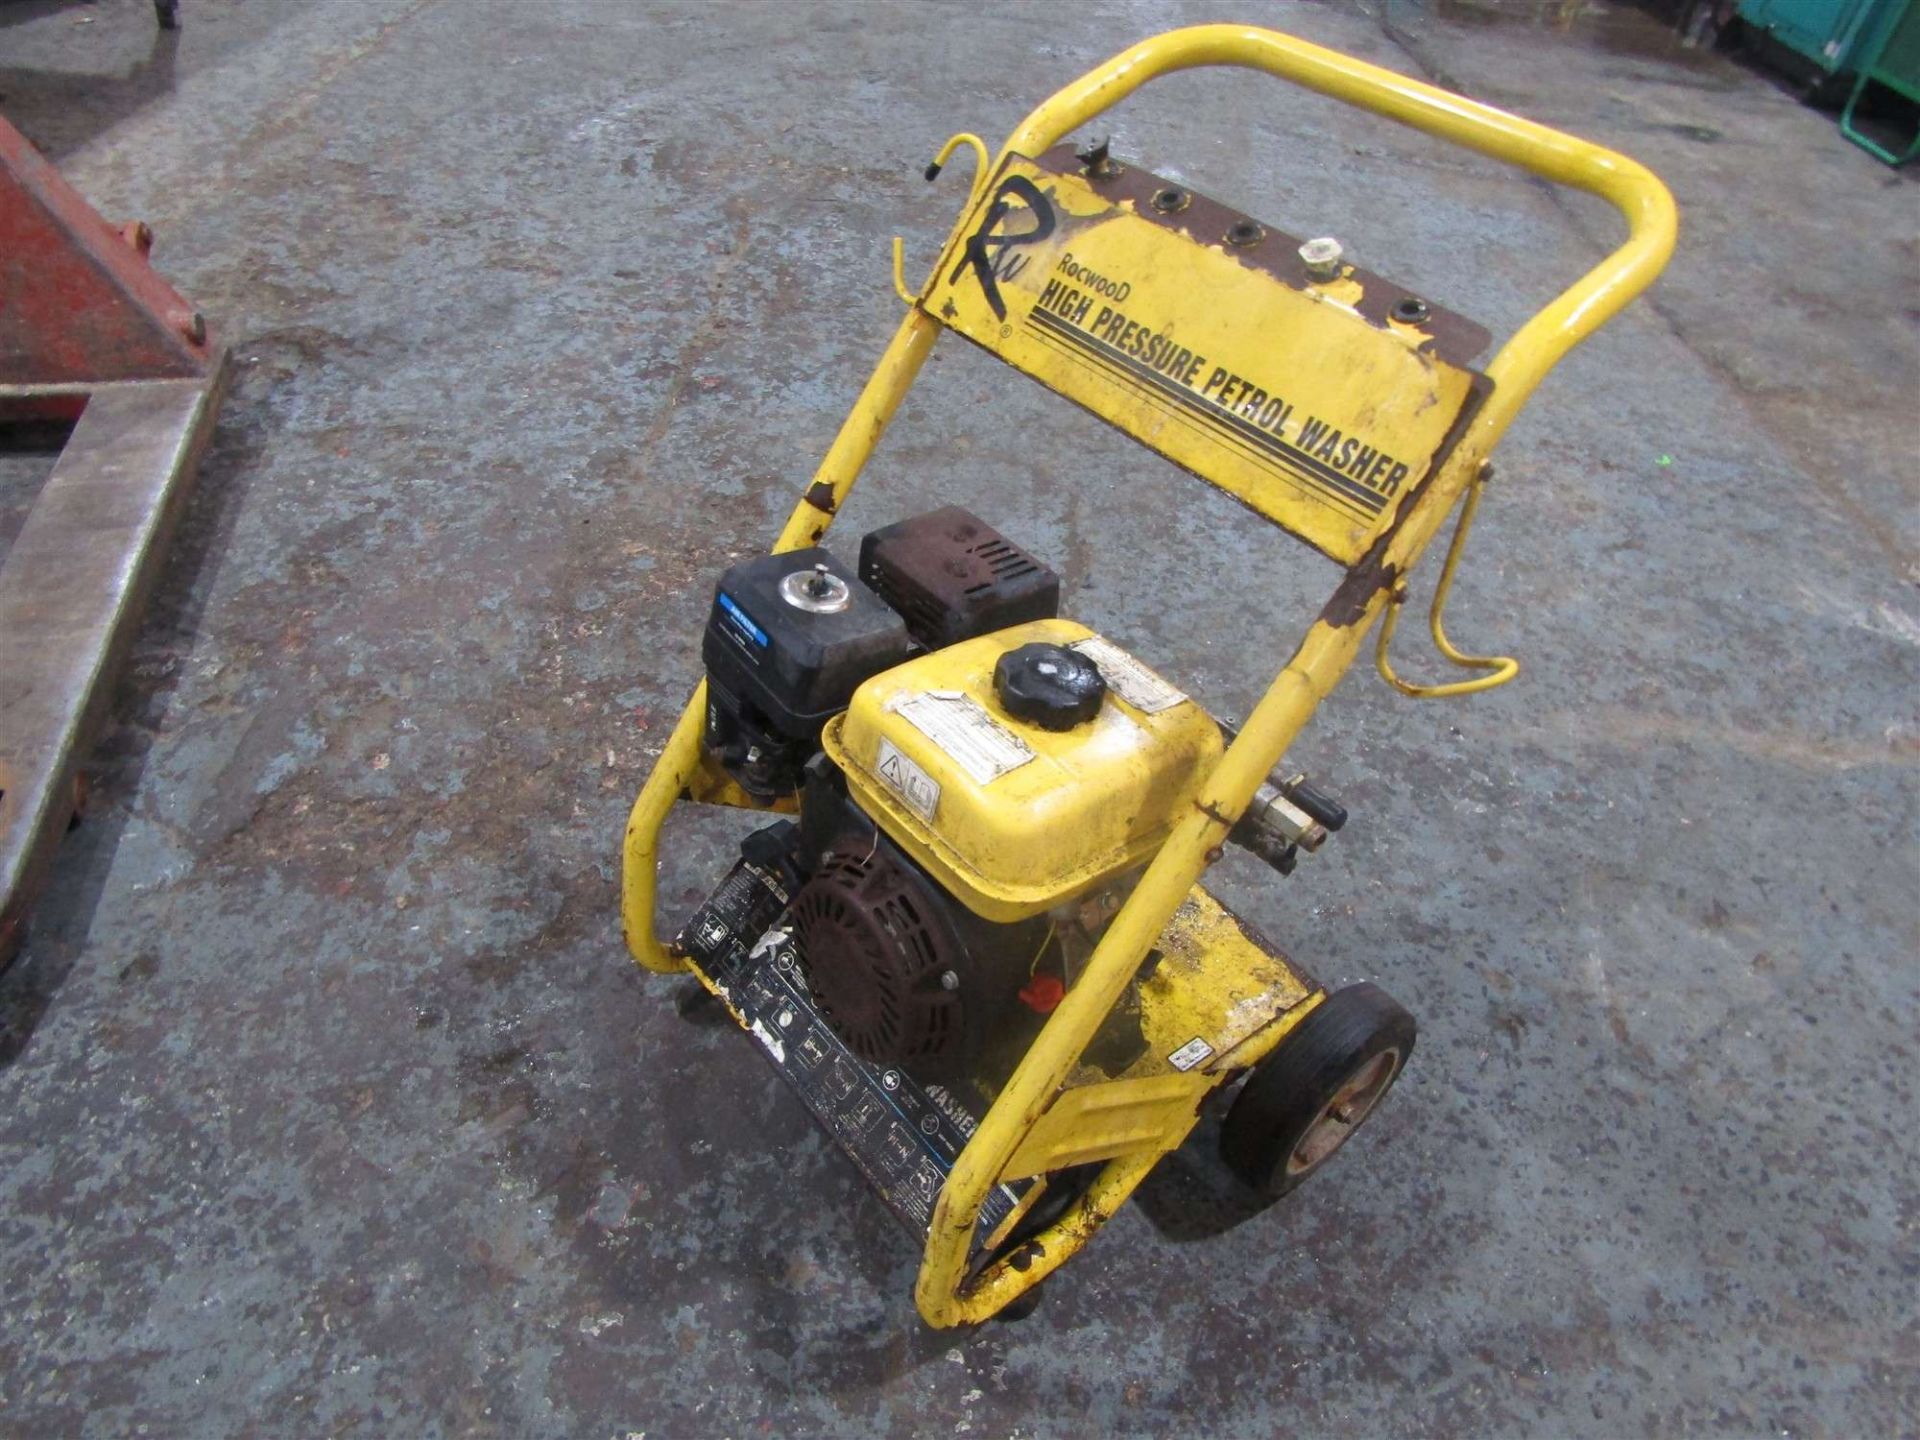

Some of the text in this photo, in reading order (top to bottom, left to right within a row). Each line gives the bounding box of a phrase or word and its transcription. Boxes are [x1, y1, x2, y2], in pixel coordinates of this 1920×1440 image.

[1038, 278, 1409, 498] HIGH PRESSURE PETROL WASHER
